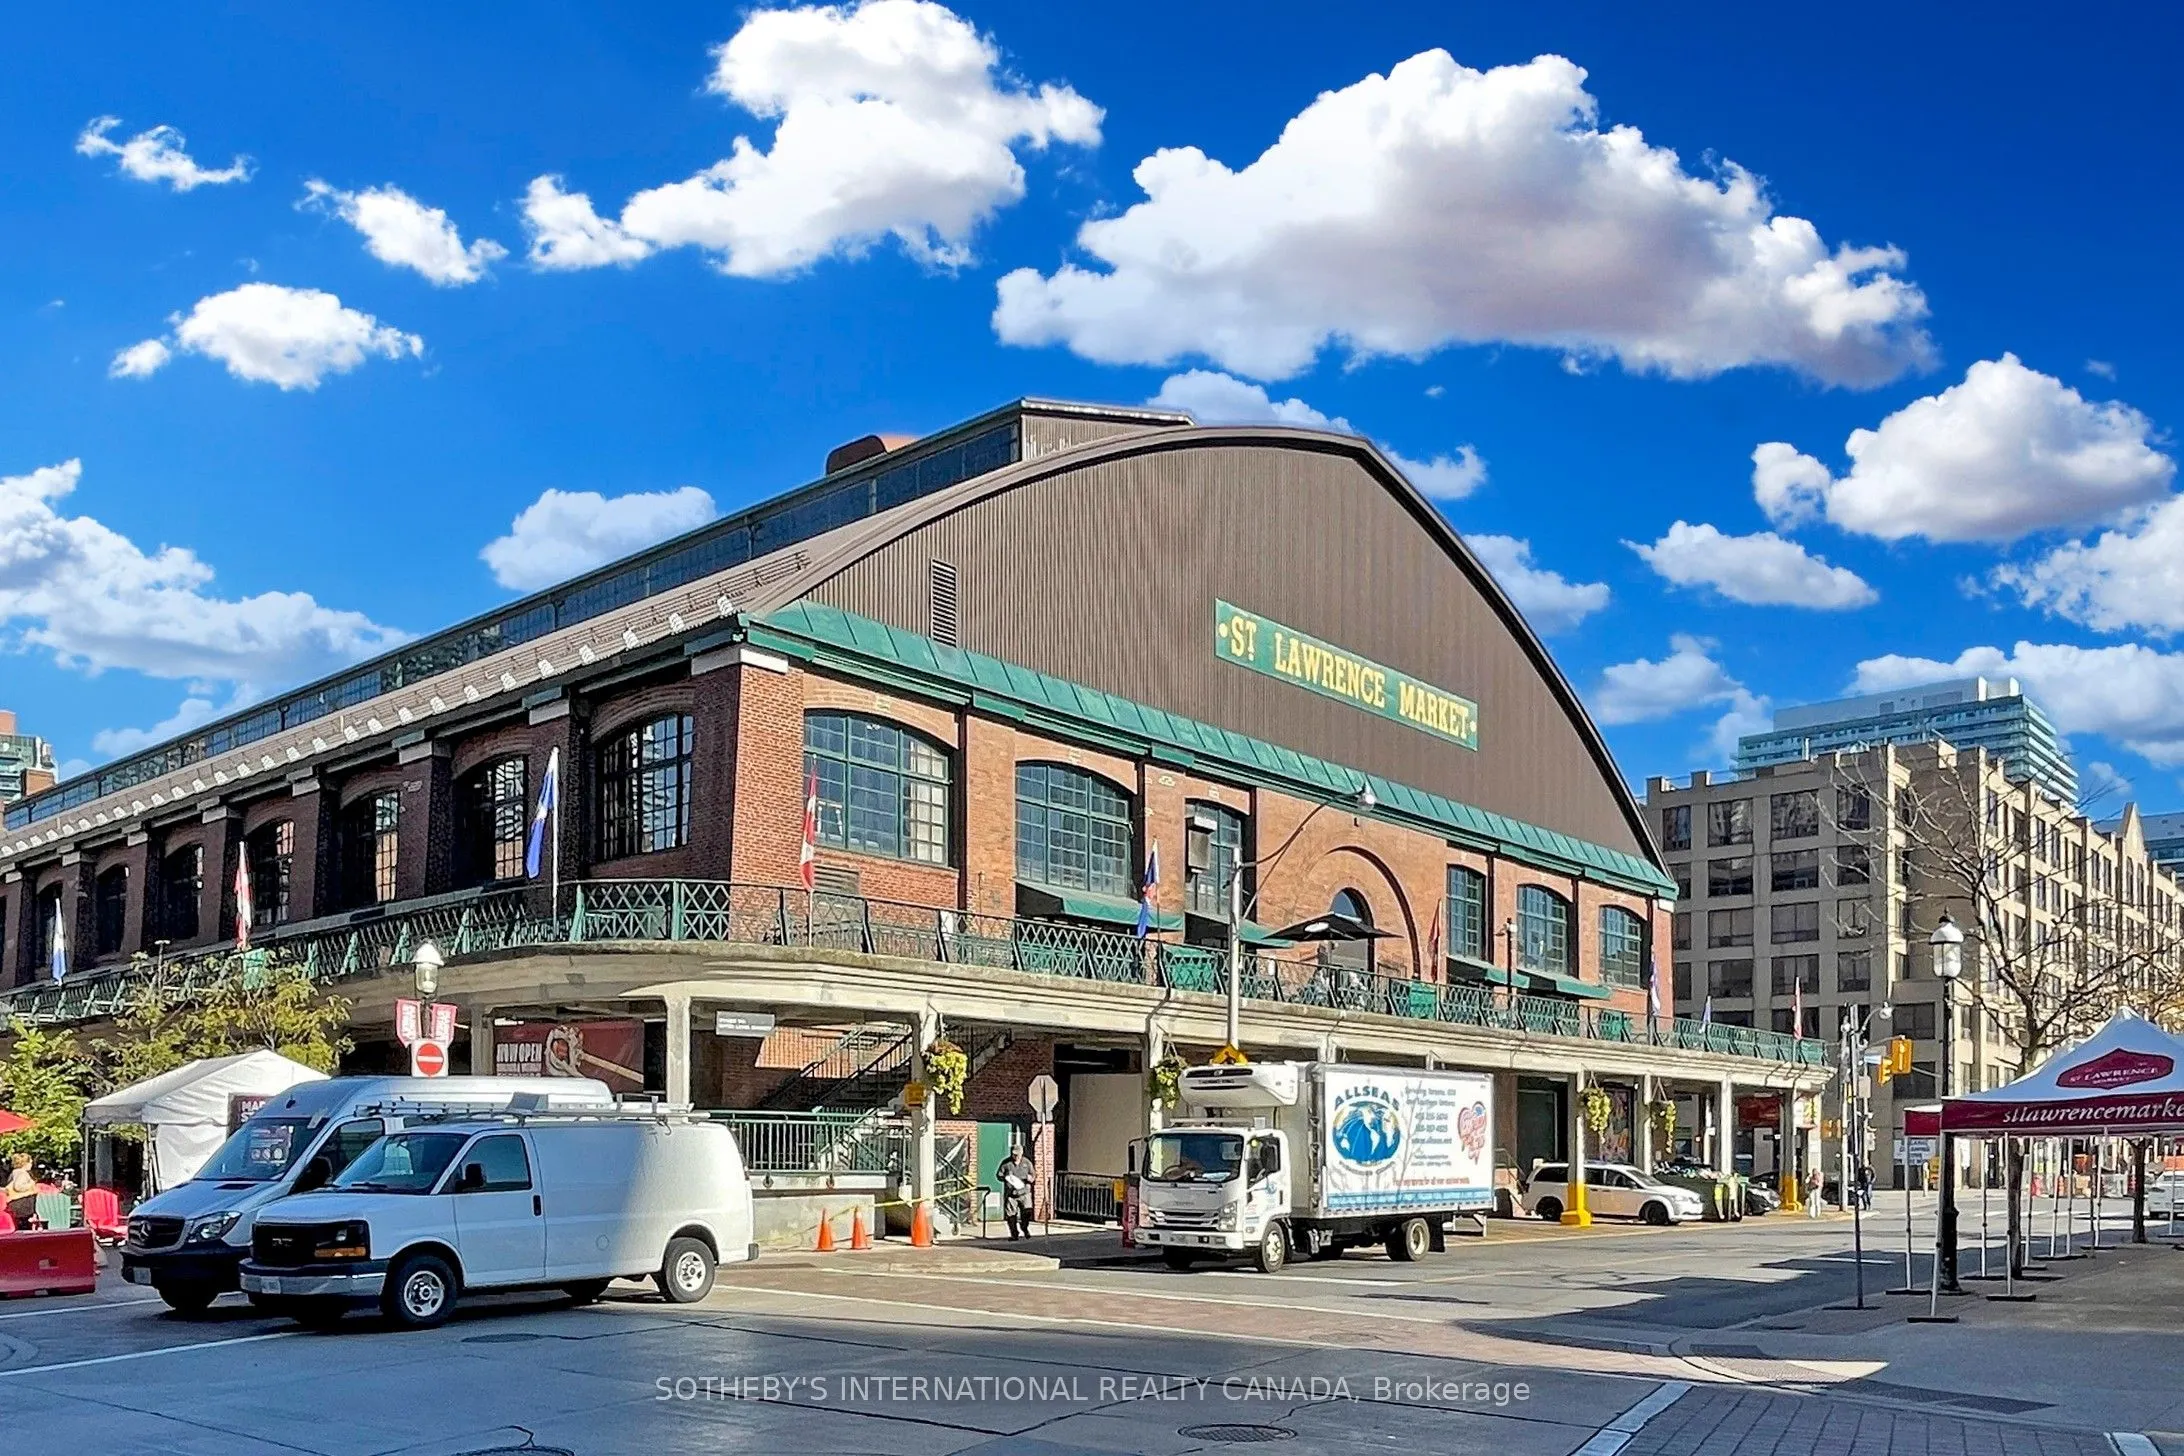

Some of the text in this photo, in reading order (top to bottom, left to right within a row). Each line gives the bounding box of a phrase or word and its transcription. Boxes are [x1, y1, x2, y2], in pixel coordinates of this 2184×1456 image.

[1274, 632, 1386, 709] LAWRENCE
[1399, 681, 1469, 740] MARKET
[496, 1043, 542, 1063] NOW OPEN
[2084, 1067, 2159, 1081] LAWRENCE
[1334, 1085, 1400, 1111] ALLSEAS
